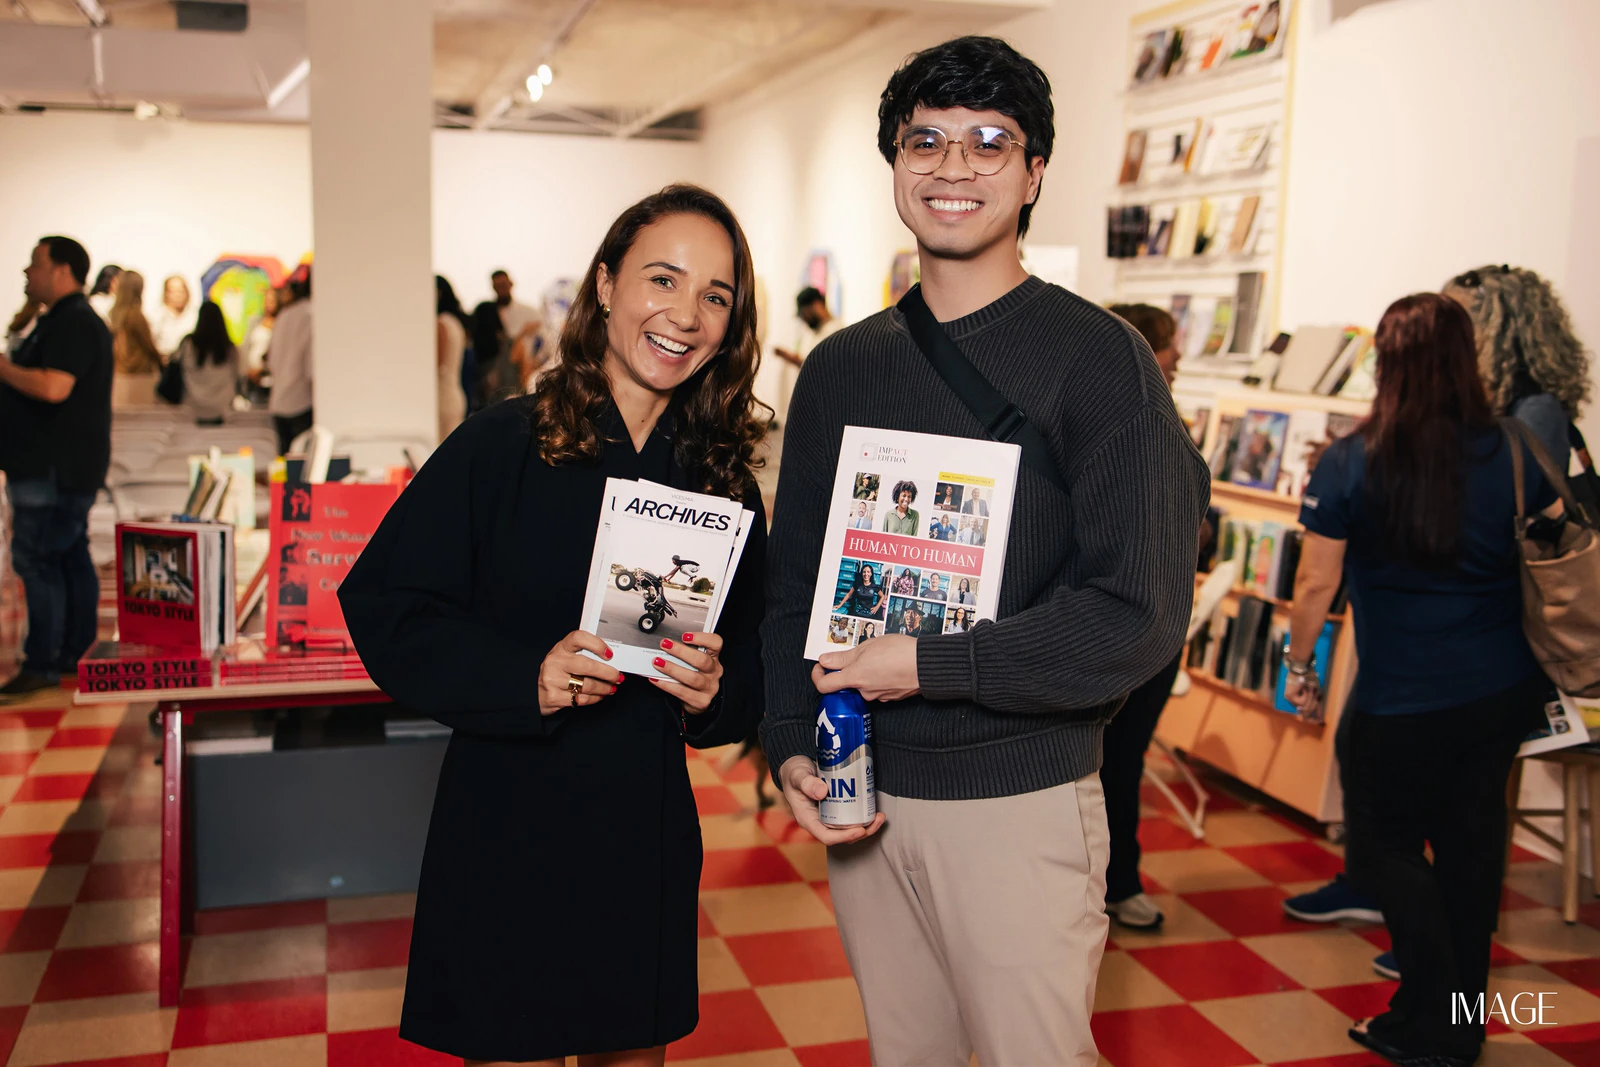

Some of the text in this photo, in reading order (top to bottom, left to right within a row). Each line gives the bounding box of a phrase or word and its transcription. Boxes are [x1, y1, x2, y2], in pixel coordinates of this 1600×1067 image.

[877, 455, 907, 463] EDITION
[878, 446, 908, 455] IMPACT
[624, 497, 732, 531] ARCHIVES
[848, 537, 978, 569] HUMAN TO HUMAN
[125, 600, 195, 622] TOKYO STYLE
[86, 659, 198, 676] TOKYO STYLE
[87, 675, 199, 693] TOKYO STYLE
